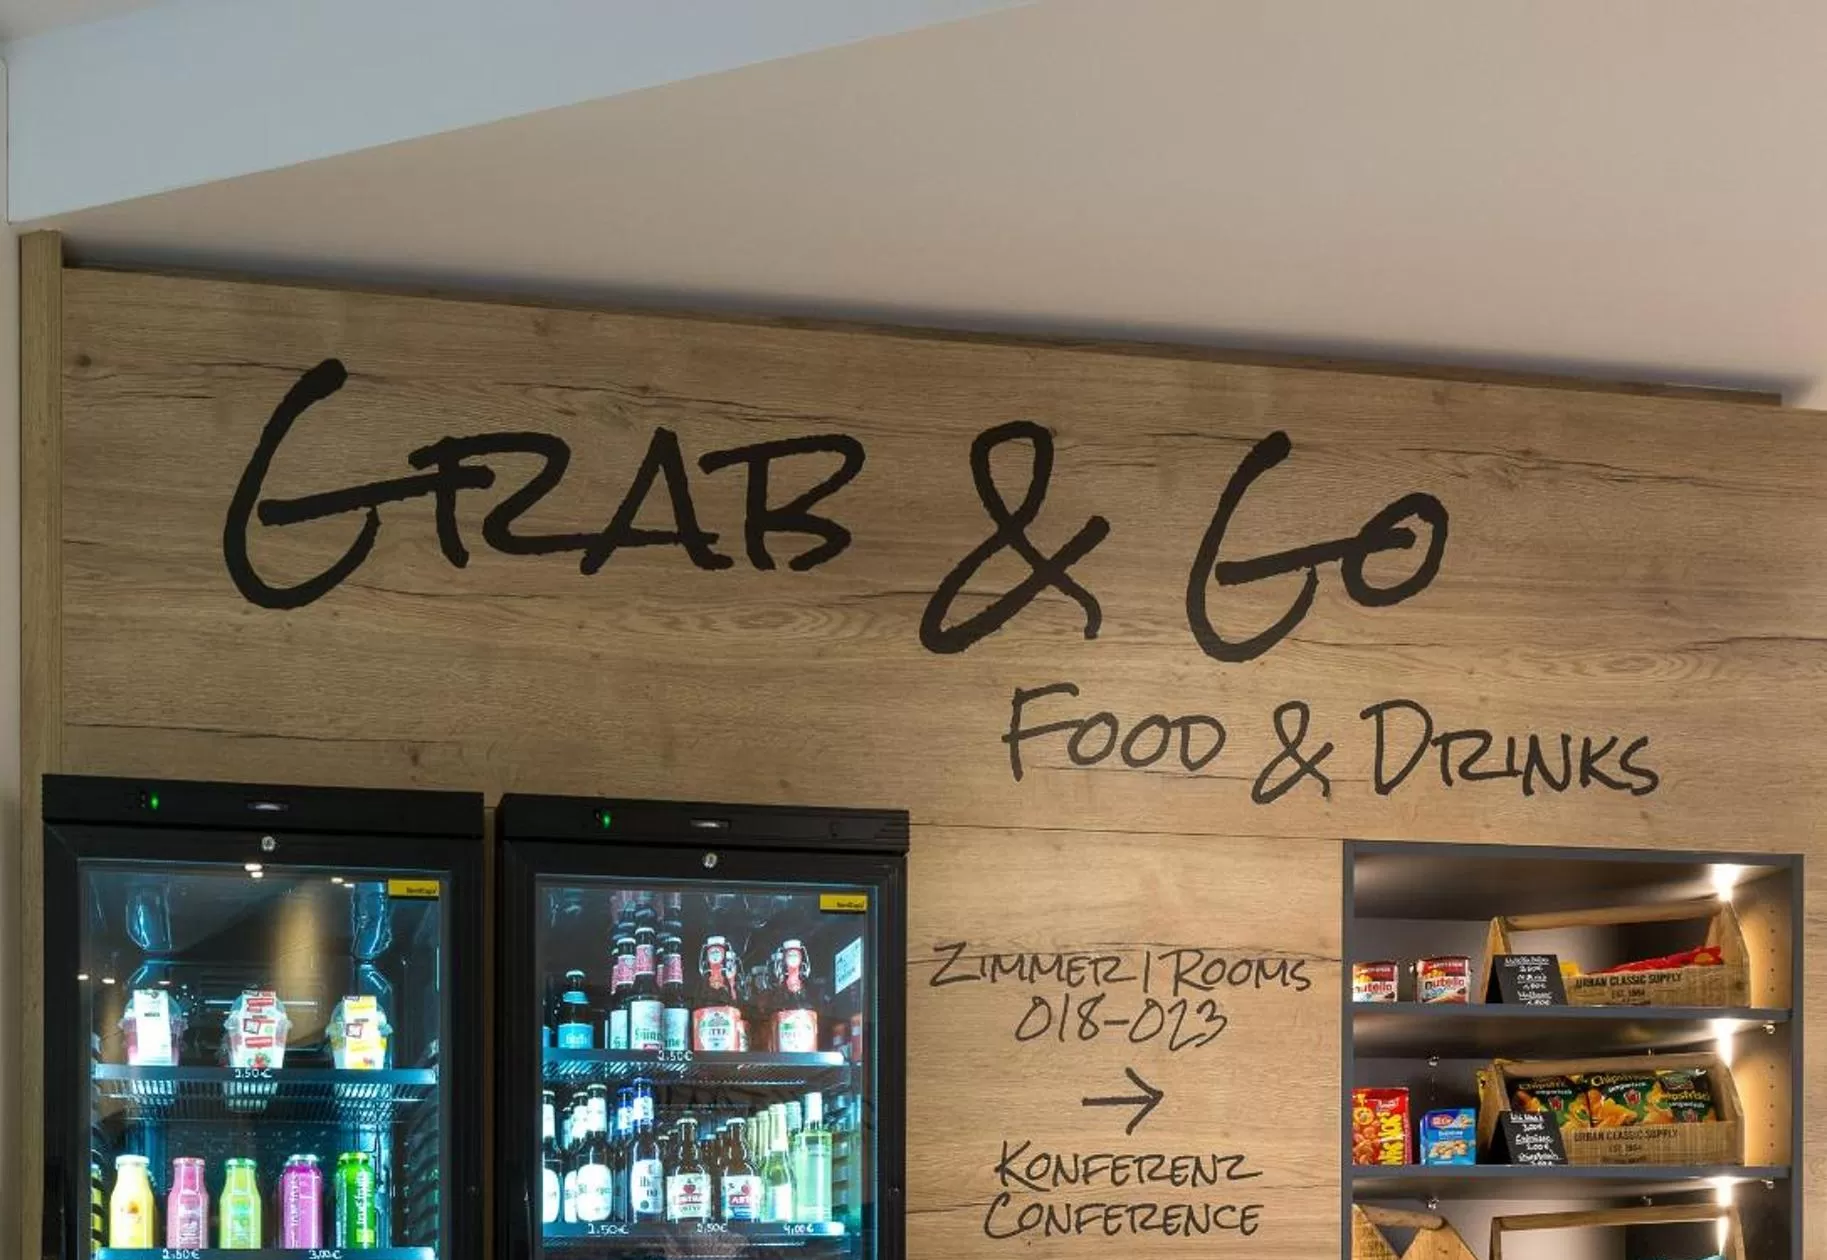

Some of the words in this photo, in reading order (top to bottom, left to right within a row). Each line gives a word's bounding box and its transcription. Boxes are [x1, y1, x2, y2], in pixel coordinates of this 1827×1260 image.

[224, 359, 865, 610] GRAB
[914, 420, 1110, 654] &
[1186, 430, 1449, 663] GO
[1002, 683, 1228, 781] FOOD
[1251, 701, 1334, 804] &
[1360, 699, 1660, 796] DRINKS
[930, 941, 1137, 988] ZIMMER
[1158, 947, 1312, 997] ROOMS
[1610, 974, 1645, 986] CLASSIC
[1648, 972, 1682, 984] SUPPLY
[1015, 992, 1227, 1052] 018-023
[1645, 1128, 1678, 1139] SUPPLY
[994, 1140, 1263, 1191] KONFERENZ
[984, 1192, 1264, 1239] CONFERENCE
